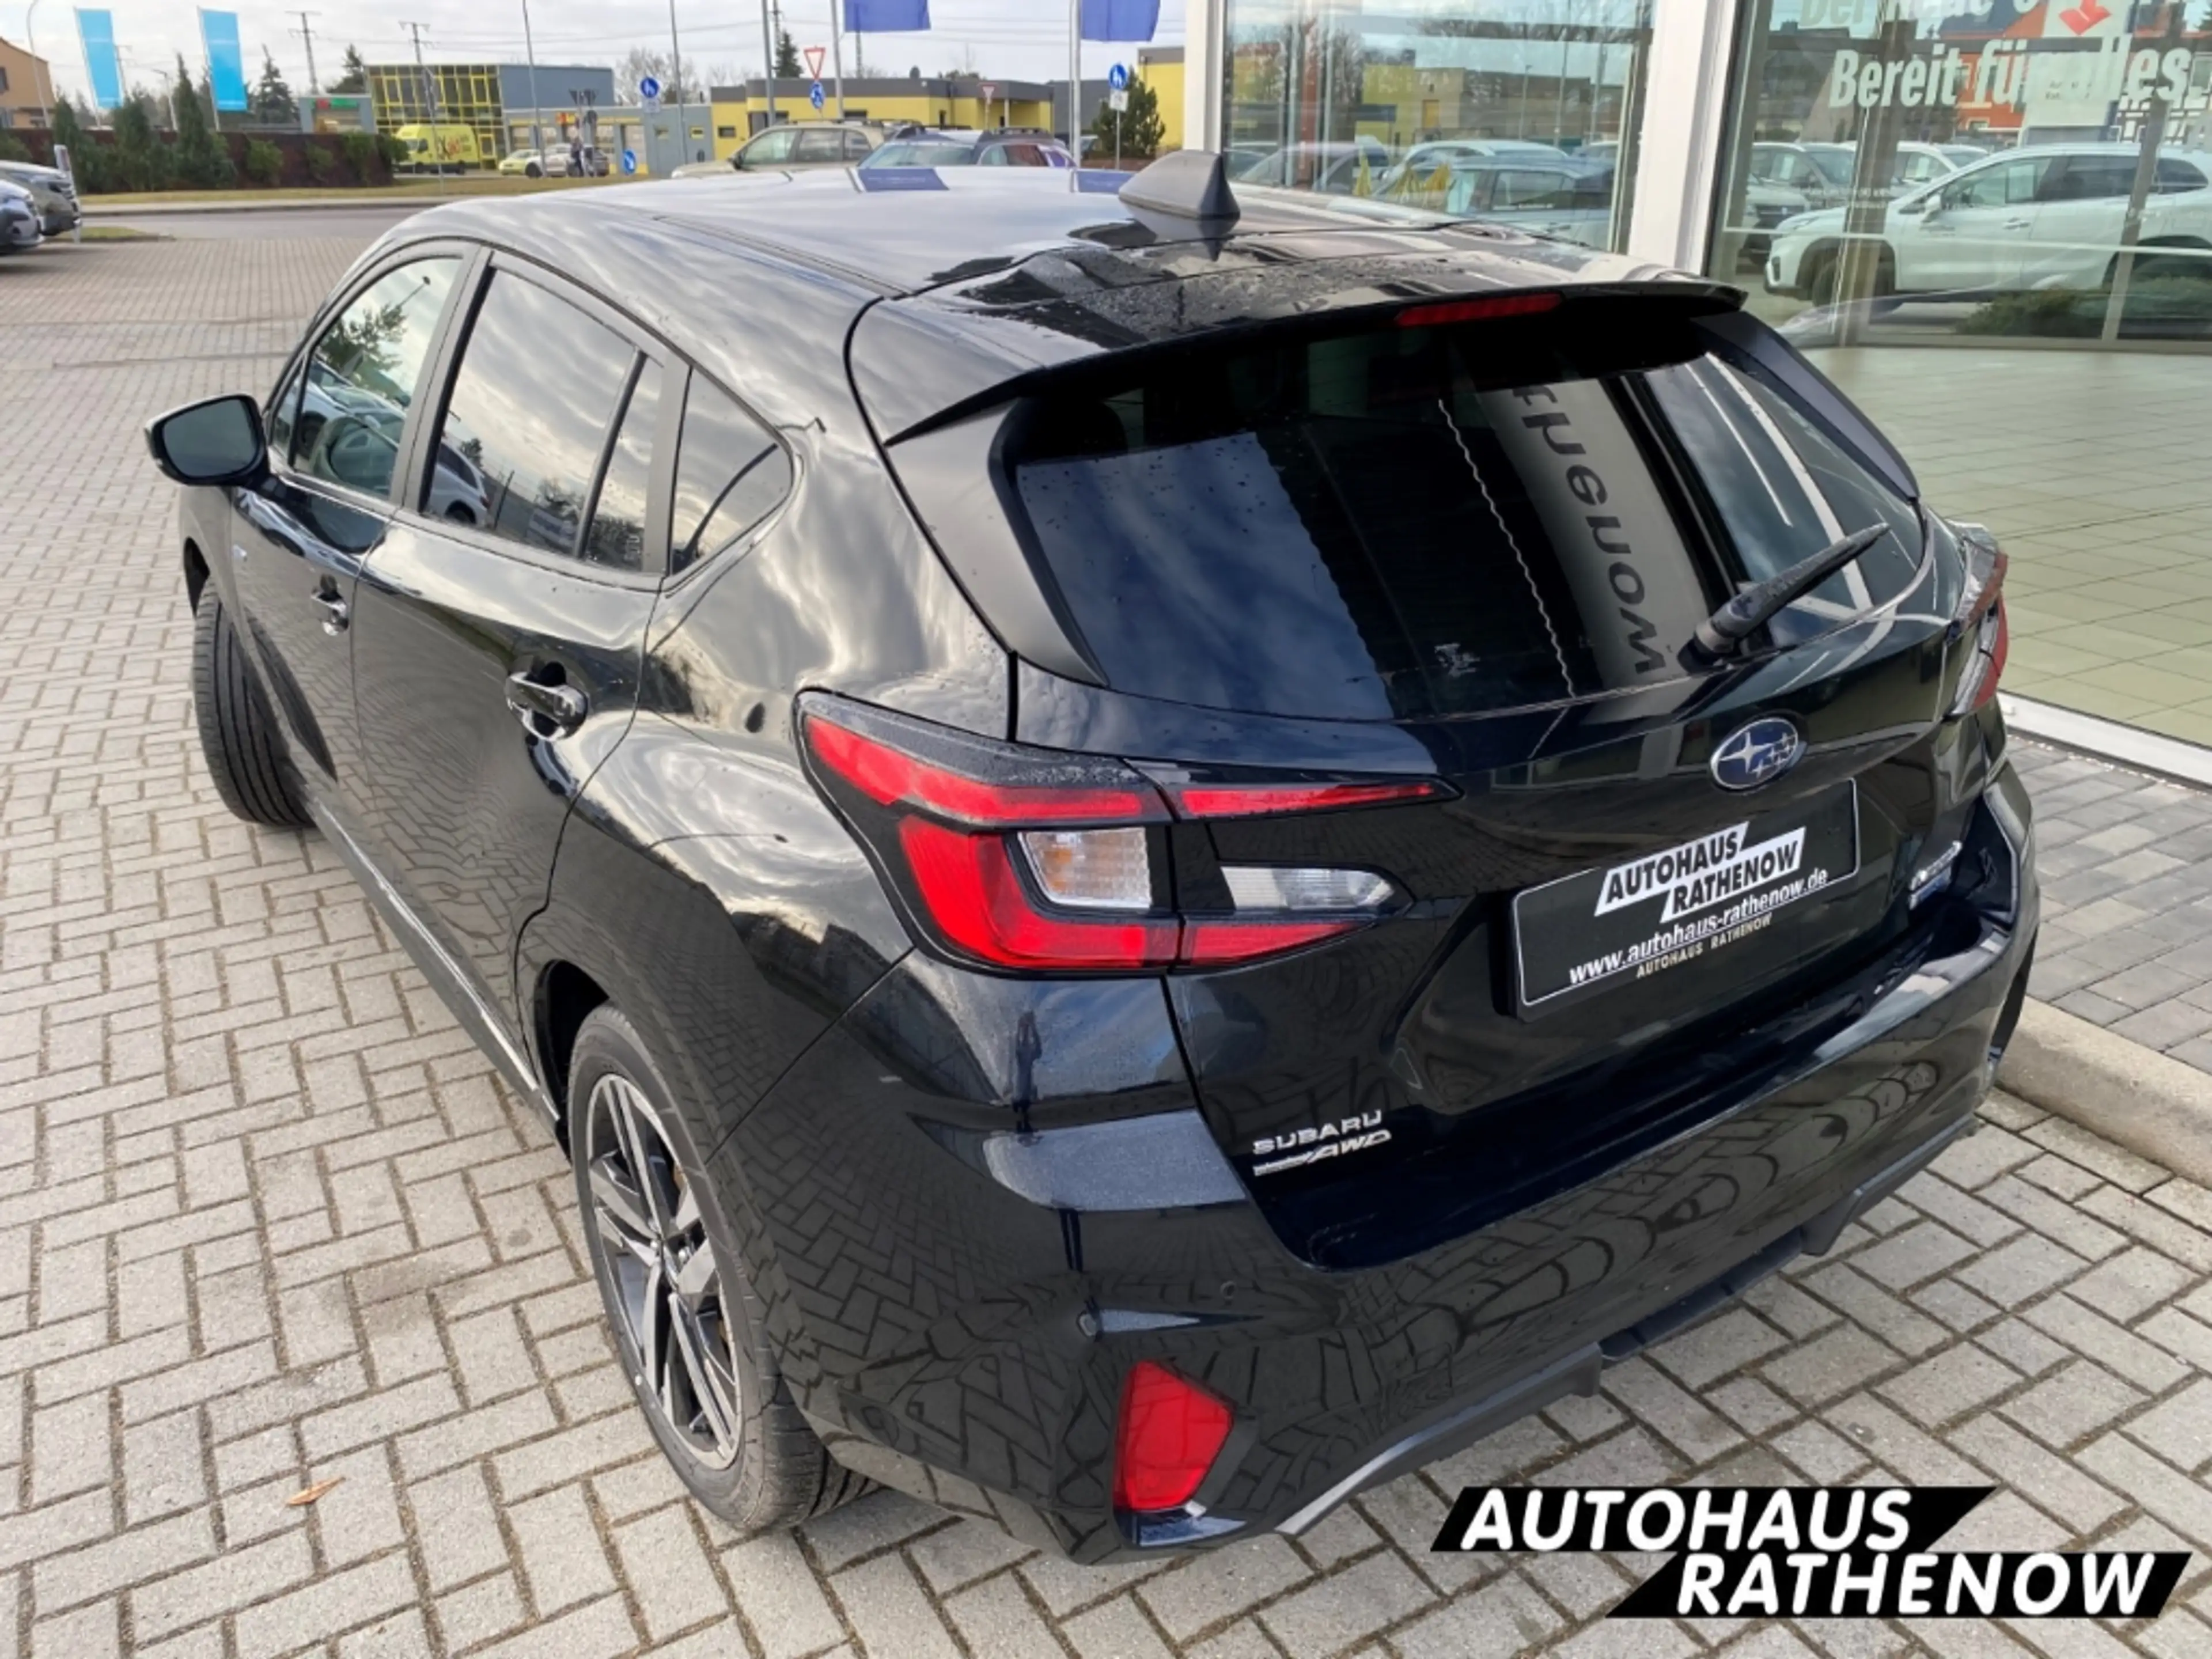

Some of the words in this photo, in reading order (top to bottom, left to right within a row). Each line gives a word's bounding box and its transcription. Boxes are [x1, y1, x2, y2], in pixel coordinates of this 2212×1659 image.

[1828, 43, 1960, 108] Bereit
[1975, 38, 2048, 107] für
[1605, 831, 1738, 906] AUTOHAUS
[1672, 840, 1798, 914] RATHENOW
[1569, 868, 1830, 984] www.autohaus-rathenow.de
[1636, 941, 1703, 979] AUTOHAUS
[1711, 912, 1772, 950] RATHENOW
[1253, 1109, 1382, 1154] SUBARU
[1306, 1129, 1392, 1164] AWD
